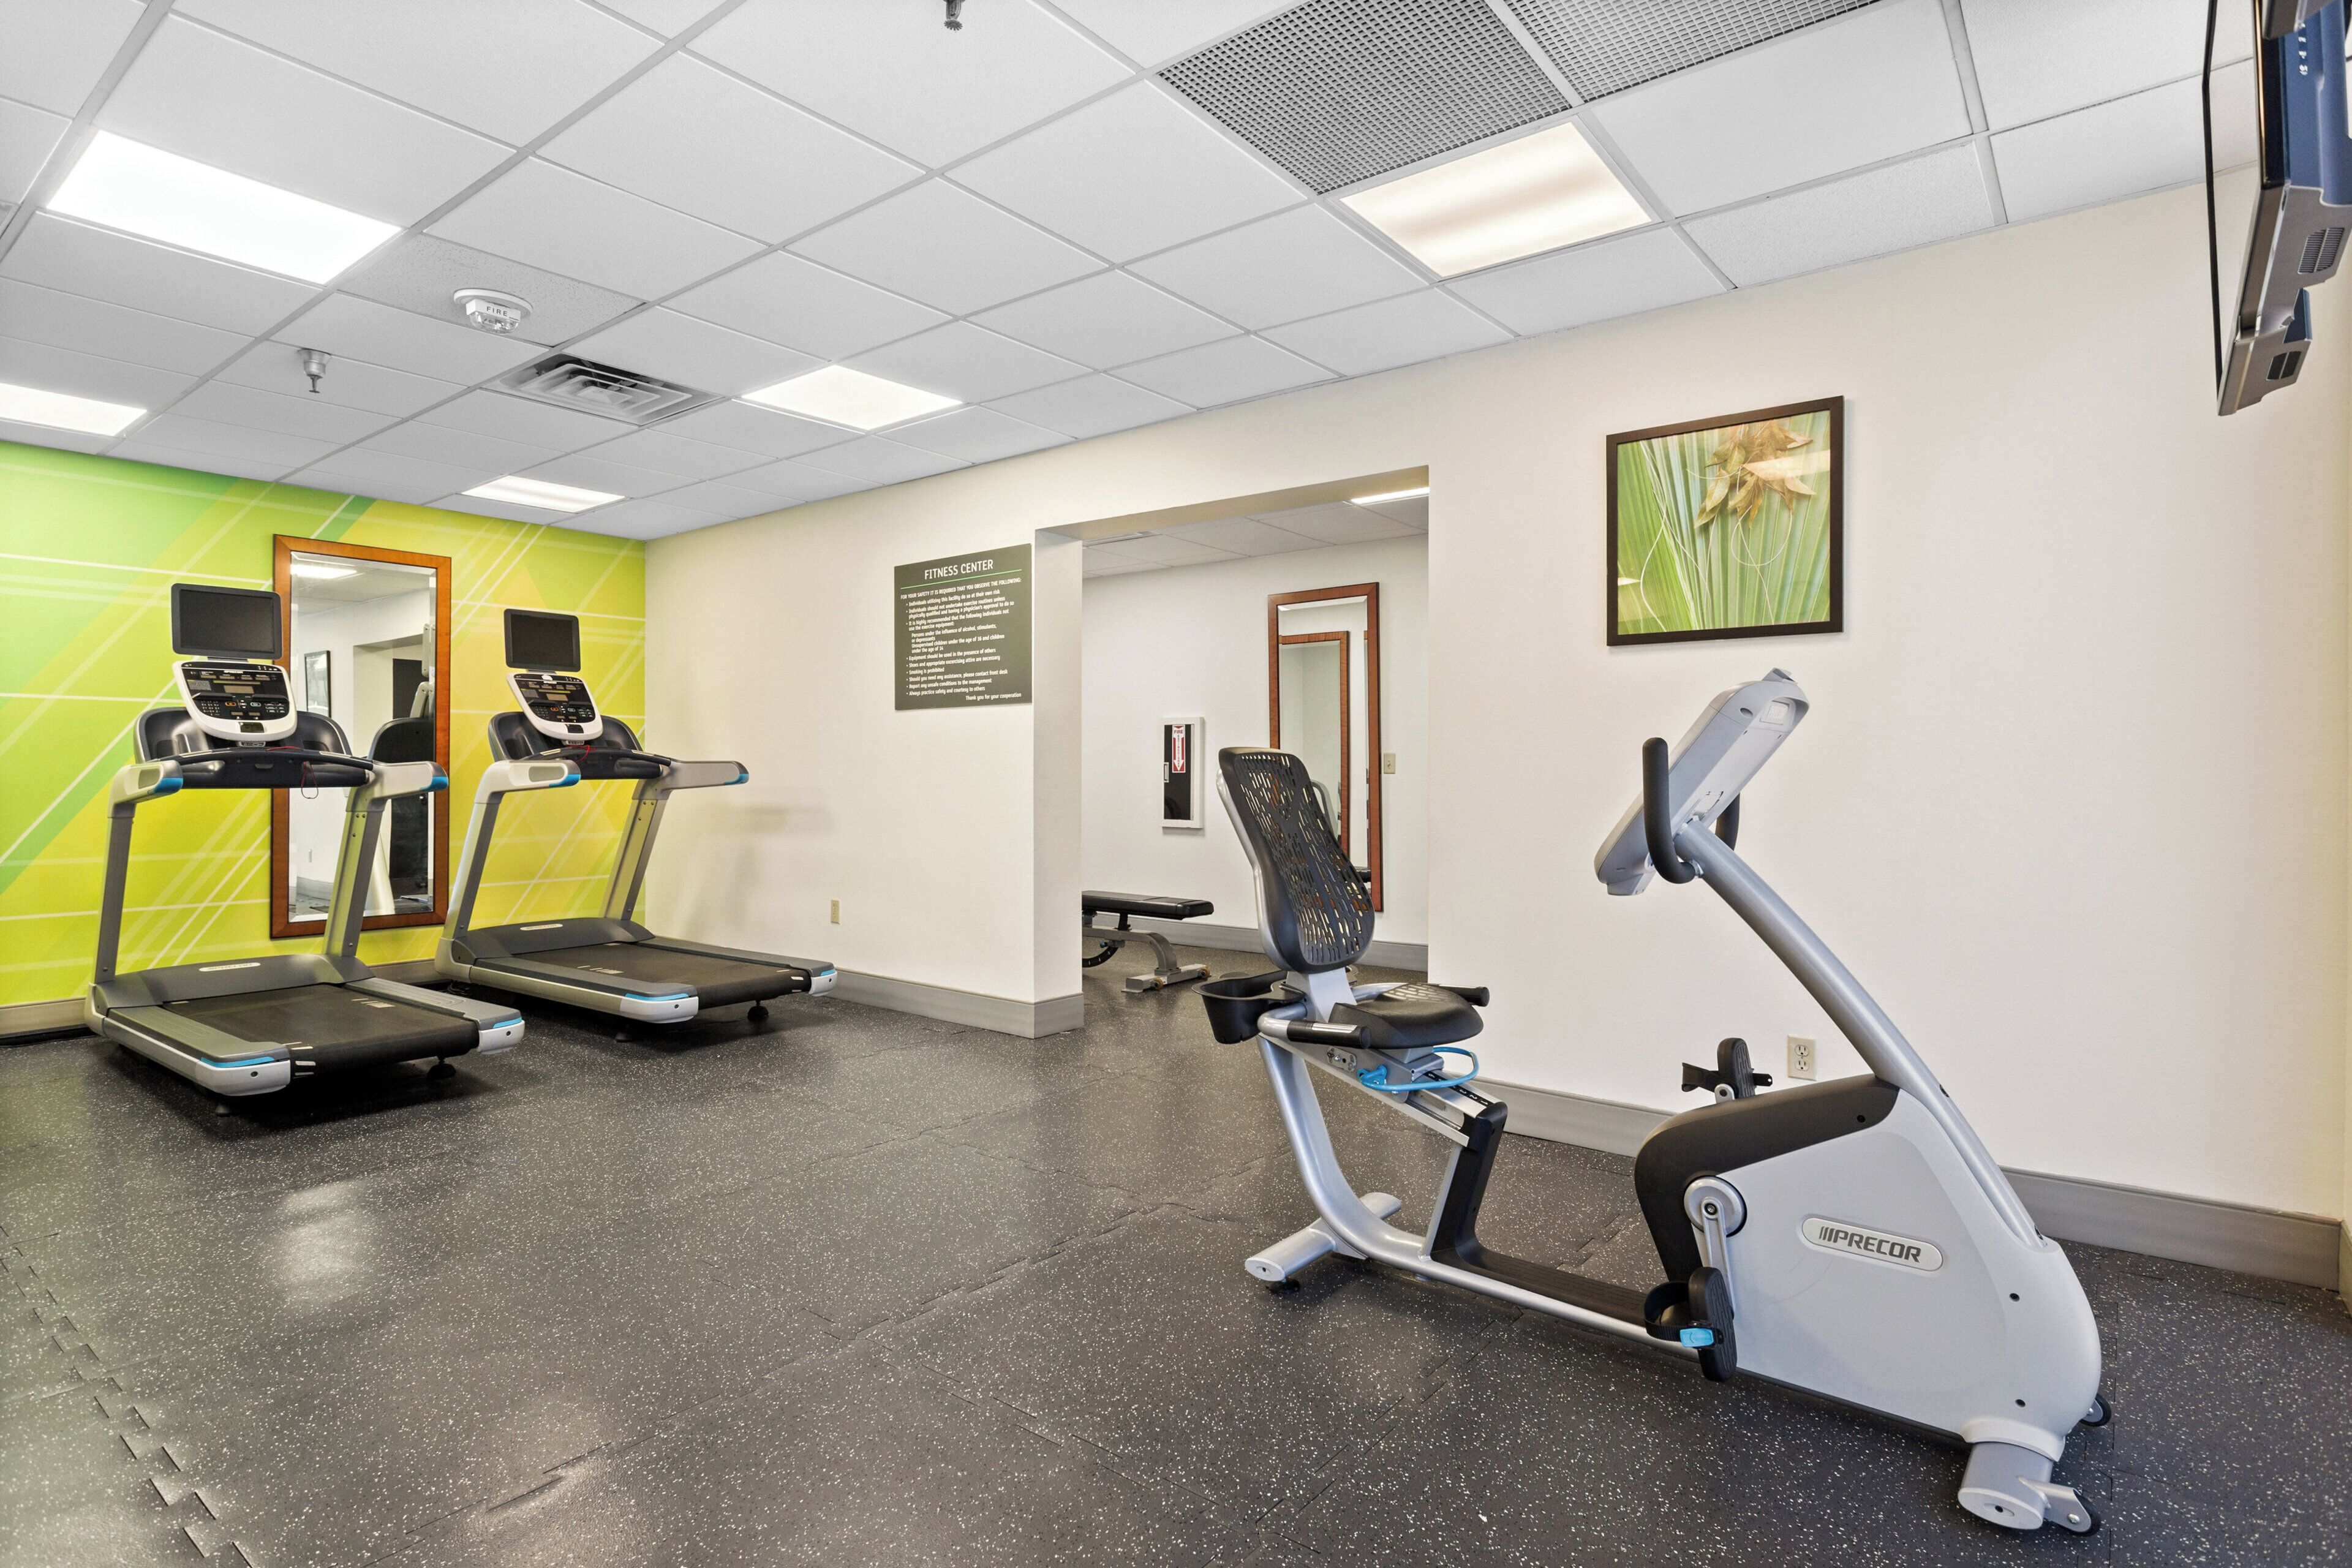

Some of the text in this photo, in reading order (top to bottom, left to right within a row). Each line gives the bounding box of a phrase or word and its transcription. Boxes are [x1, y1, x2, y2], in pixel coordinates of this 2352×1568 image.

[486, 306, 508, 316] FIRE
[925, 559, 993, 580] FITNESS CENTER
[963, 605, 982, 613] physician's
[1832, 1229, 1921, 1262] PRECOR
